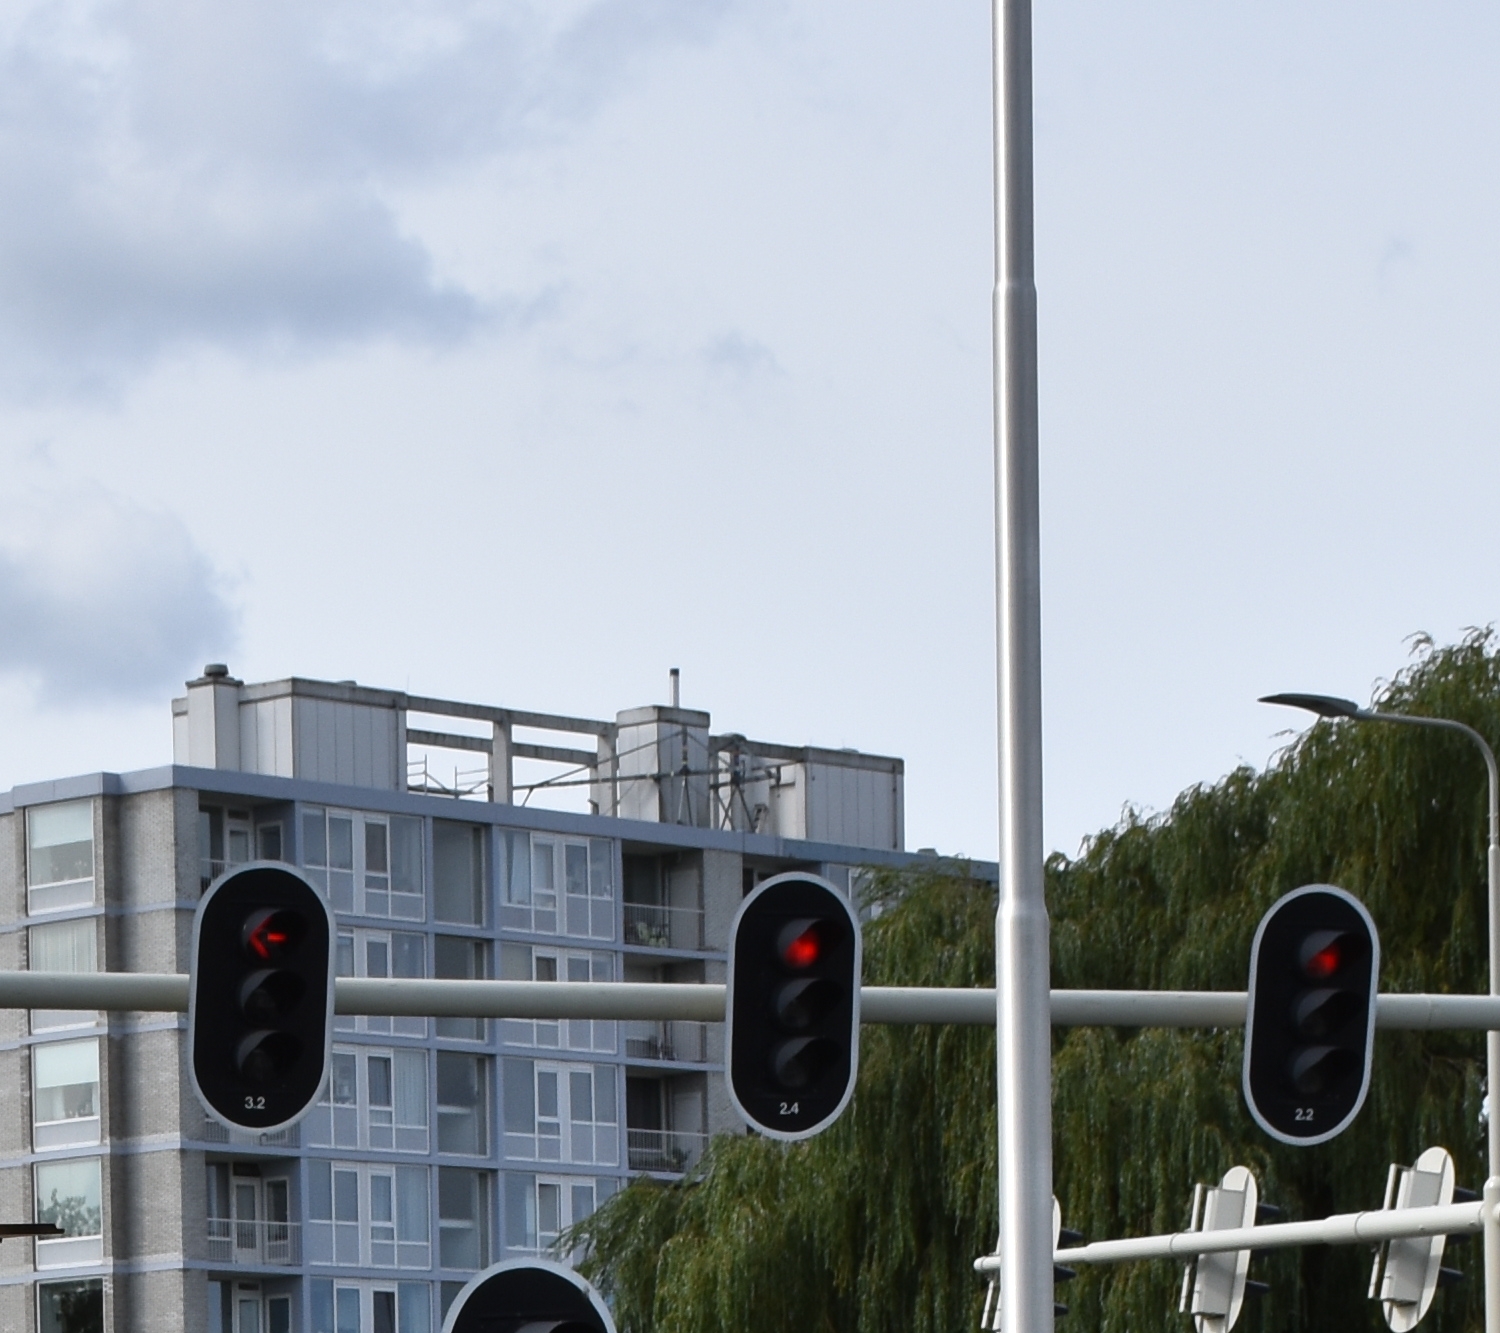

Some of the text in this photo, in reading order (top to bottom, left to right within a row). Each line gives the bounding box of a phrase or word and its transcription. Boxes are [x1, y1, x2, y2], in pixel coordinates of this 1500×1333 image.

[244, 1095, 266, 1110] 3.2
[779, 1101, 799, 1115] 2.4
[1294, 1107, 1315, 1121] 2.2
